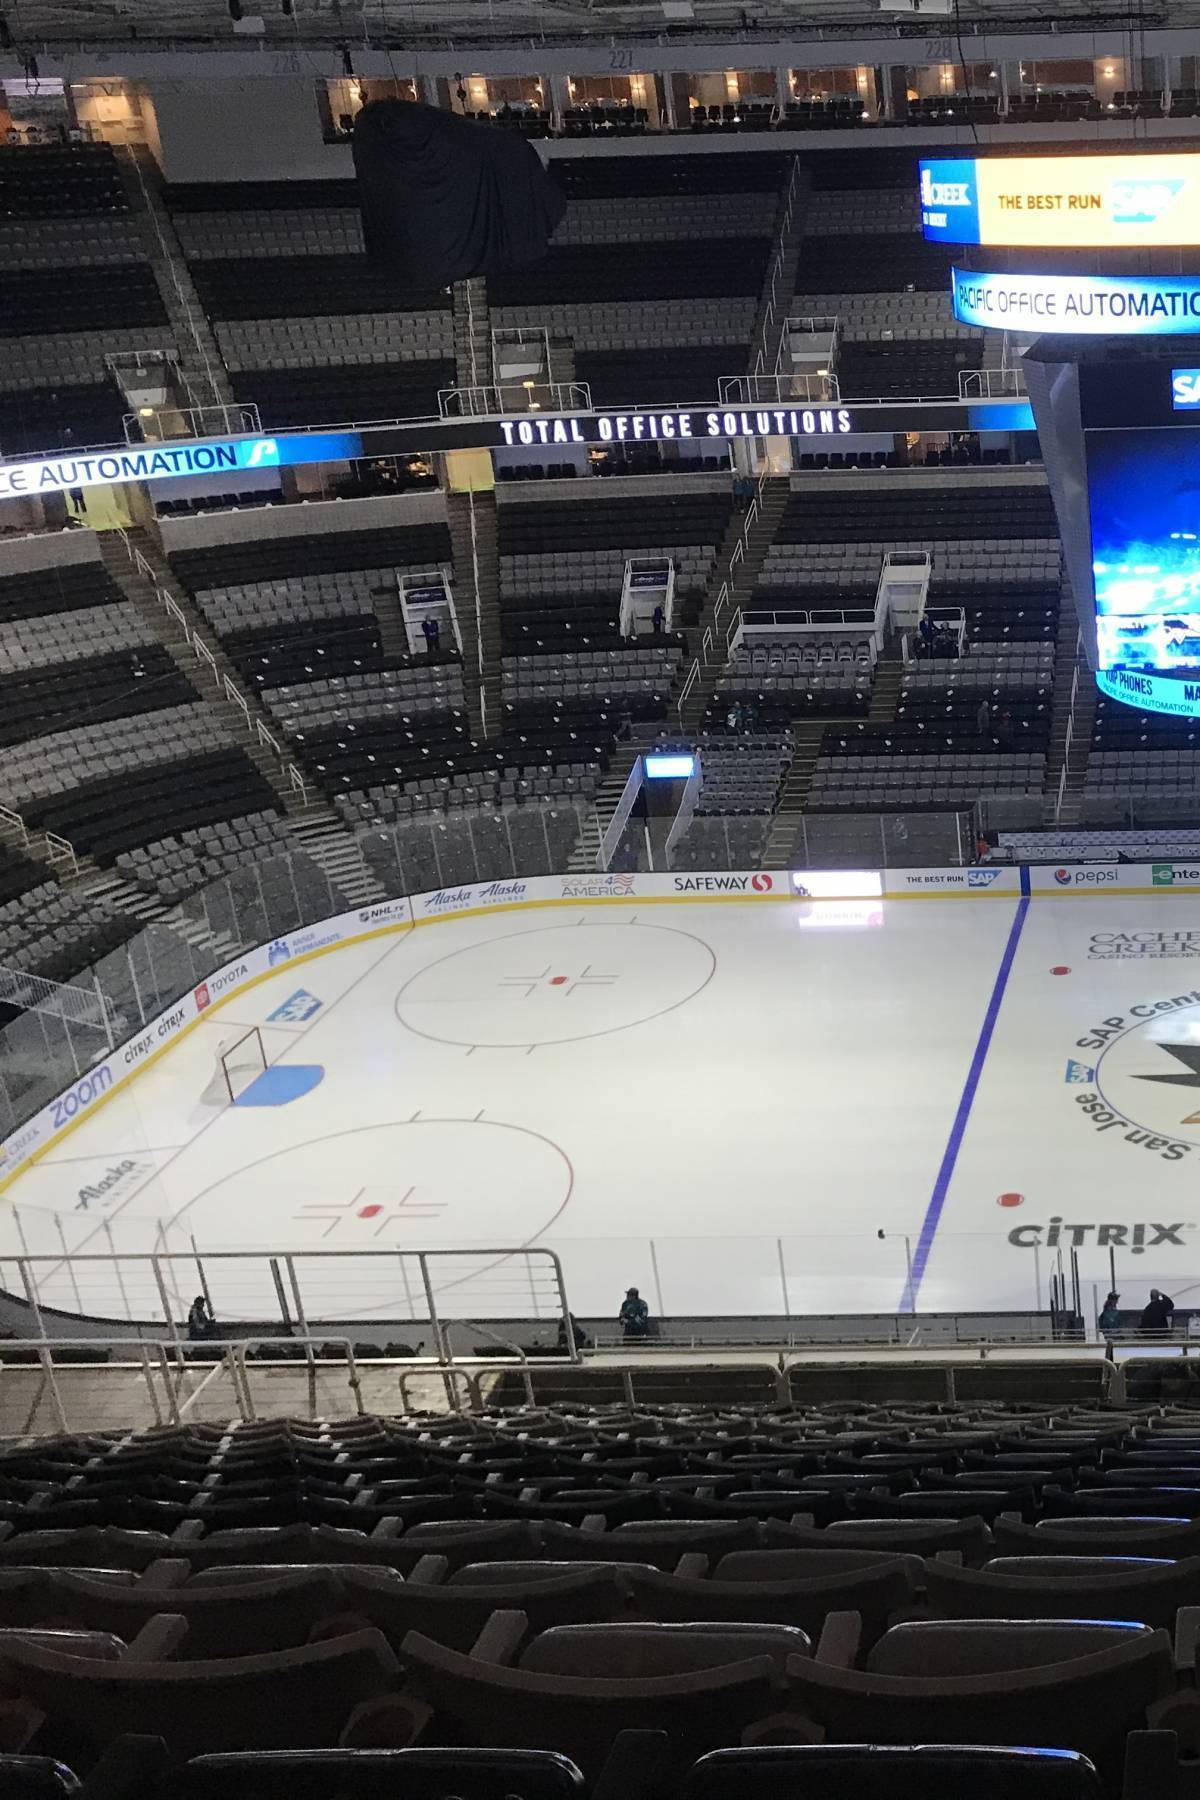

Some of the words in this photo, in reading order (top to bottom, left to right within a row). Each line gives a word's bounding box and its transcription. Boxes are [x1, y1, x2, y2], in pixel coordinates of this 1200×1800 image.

[925, 41, 952, 59] 228
[608, 51, 633, 69] 227
[998, 195, 1022, 209] THE
[1027, 194, 1062, 209] BEST
[1068, 194, 1101, 209] RUN
[959, 285, 993, 311] PACIFIC
[998, 290, 1056, 315] OFFICE
[500, 421, 584, 445] TOTAL
[599, 414, 692, 440] OFFICE
[707, 410, 851, 436] SOLUTIONS
[39, 445, 238, 487] AUTOMATION
[1119, 672, 1152, 695] PHONES
[1141, 697, 1194, 713] AUTOMATION
[561, 877, 604, 886] SOLAR
[674, 876, 749, 892] SAFEWAY
[906, 876, 923, 884] THE
[924, 875, 945, 883] BEST
[947, 875, 964, 883] RUN
[968, 872, 994, 885] SAP
[1075, 868, 1118, 884] pepsi
[424, 888, 472, 907] Alaska
[478, 882, 525, 898] Alaska
[561, 886, 636, 897] AMERICA
[211, 964, 248, 993] TOYOTA
[1076, 1016, 1125, 1050] SAP
[1075, 1093, 1128, 1132] Jose
[1123, 1129, 1192, 1161] San
[75, 1159, 137, 1210] Alaska
